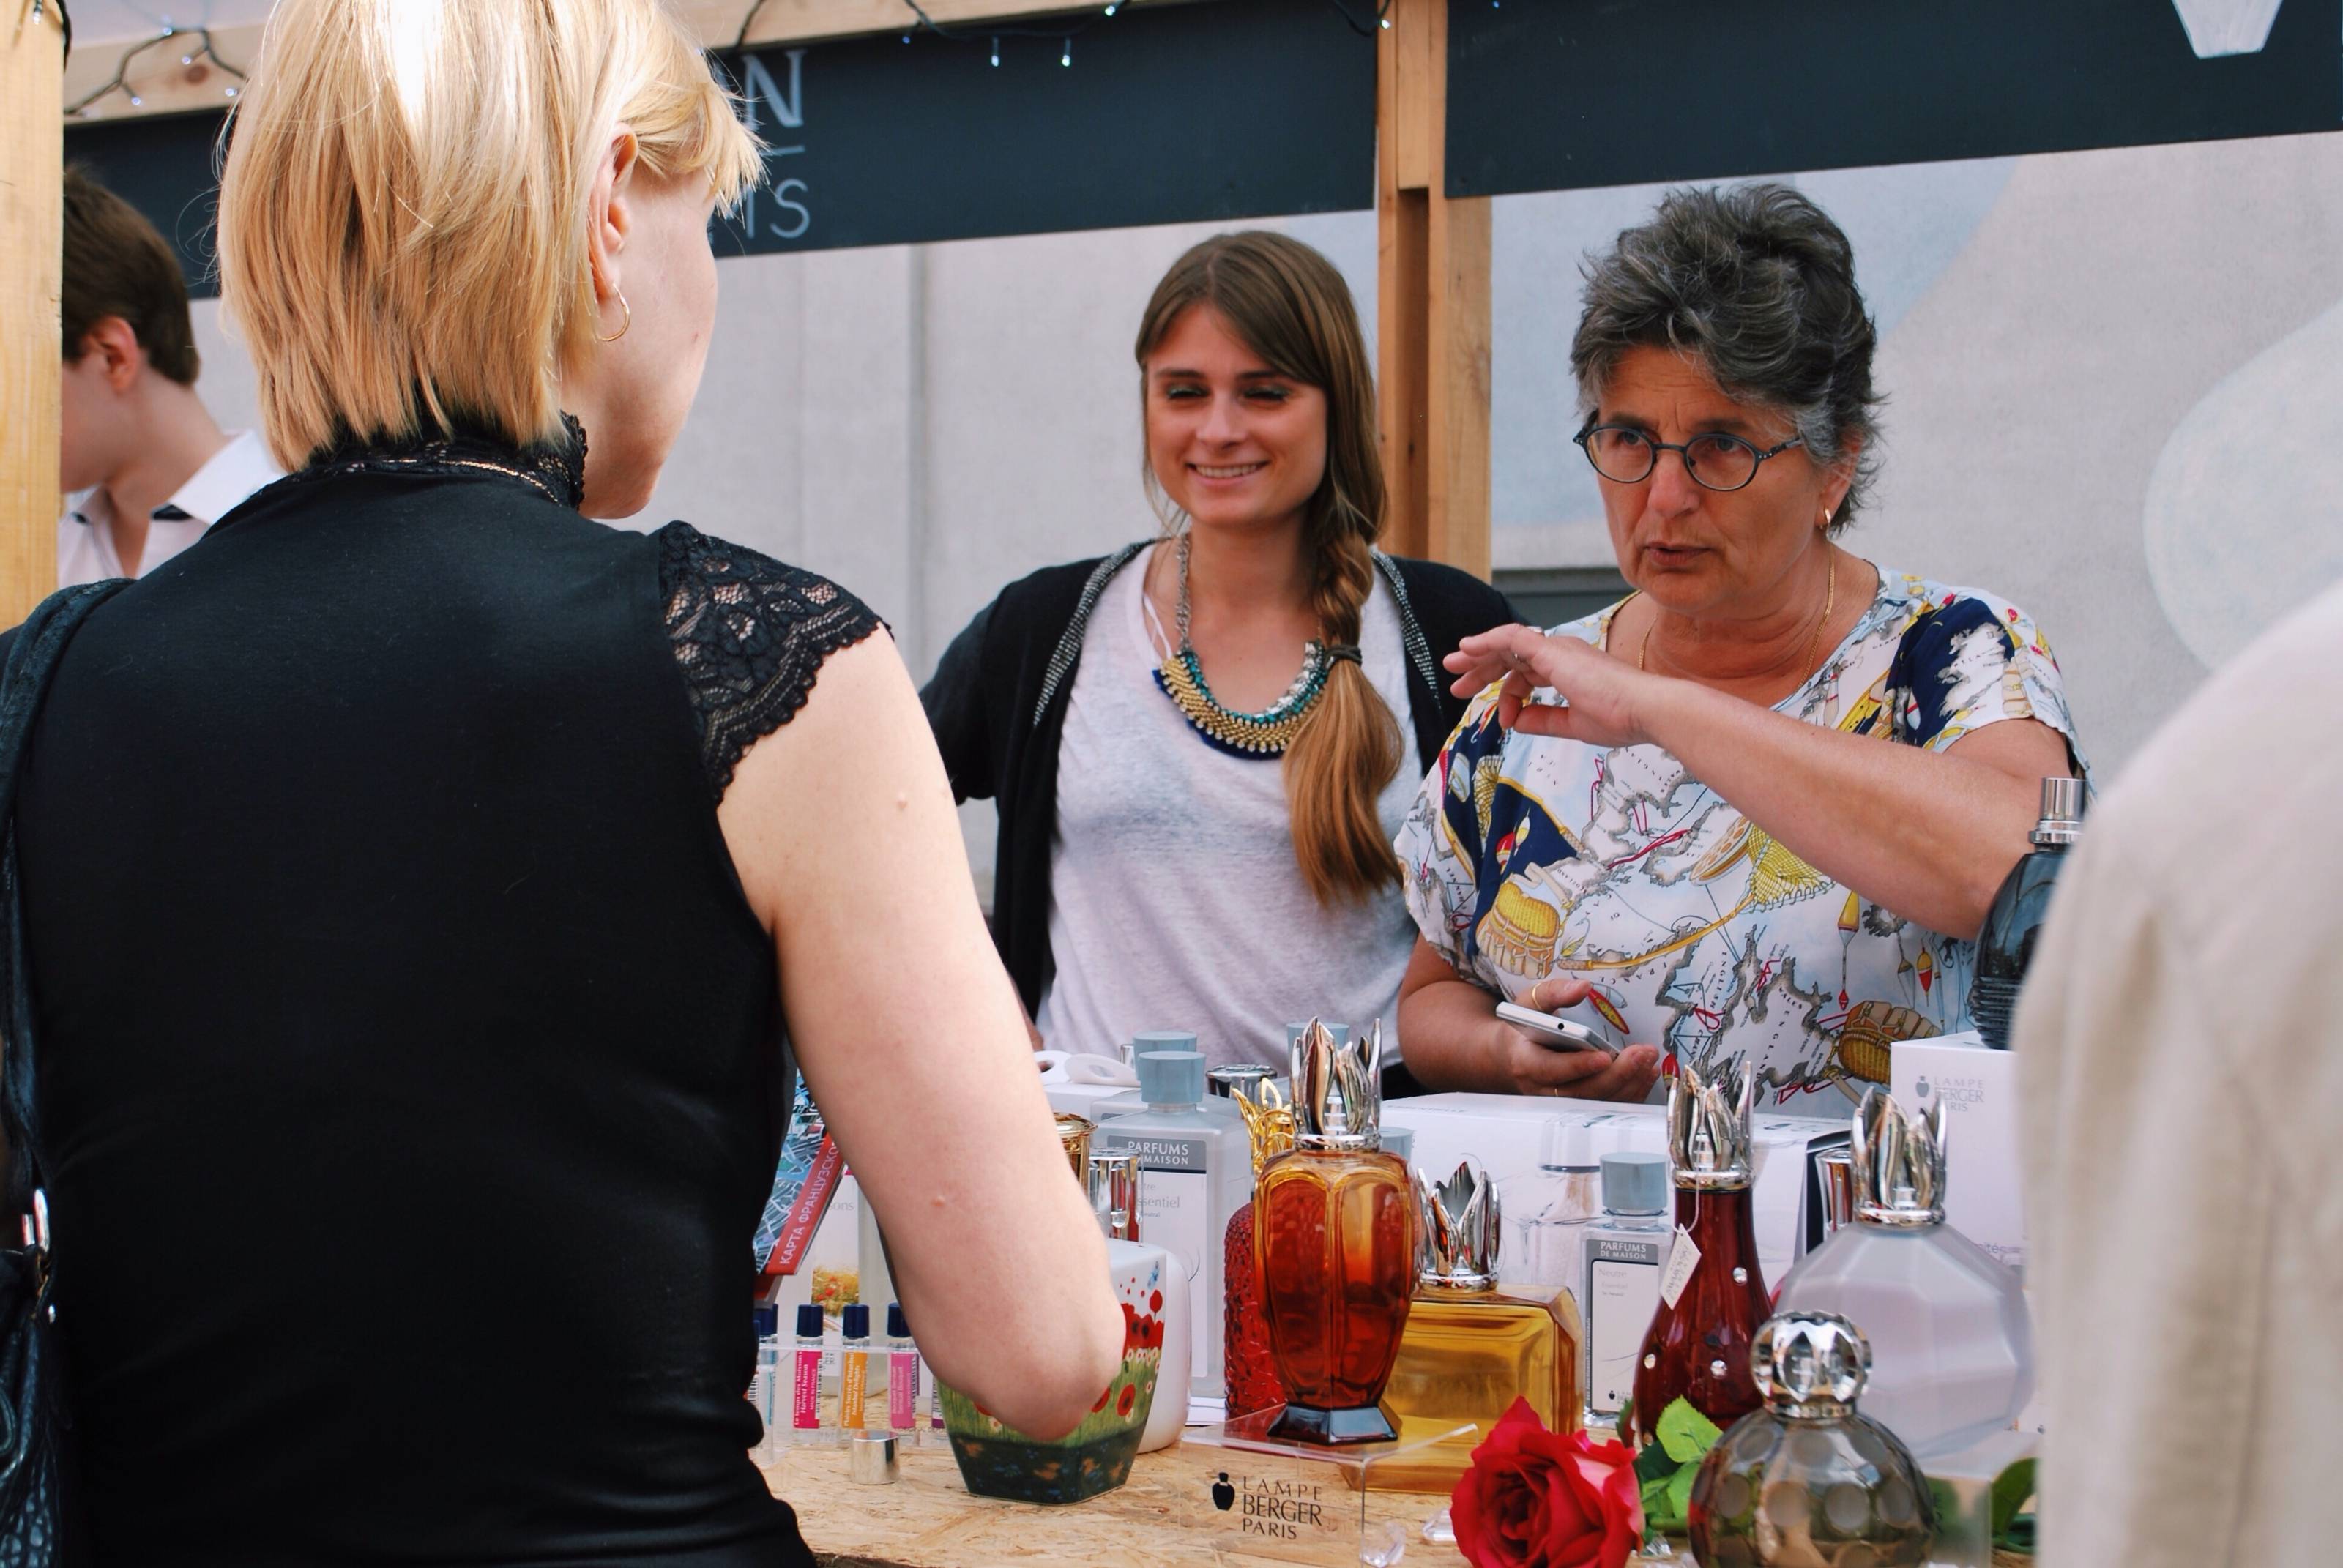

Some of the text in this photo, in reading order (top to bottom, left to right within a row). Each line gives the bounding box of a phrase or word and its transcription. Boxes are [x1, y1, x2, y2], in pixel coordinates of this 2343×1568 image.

[740, 48, 807, 130] N
[744, 178, 811, 239] IS
[1934, 1076, 1986, 1089] LAMPE
[1128, 1140, 1189, 1156] PARFUMS
[1144, 1155, 1189, 1165] MAISON
[780, 1142, 839, 1264] КАРТА ФРАНЦУЗСКО
[1600, 1241, 1647, 1253] PARFUMS
[1613, 1251, 1647, 1260] MAISON
[1243, 1475, 1323, 1501] LAMPE
[1243, 1493, 1322, 1526] BERGER
[1243, 1517, 1297, 1540] PARIS
